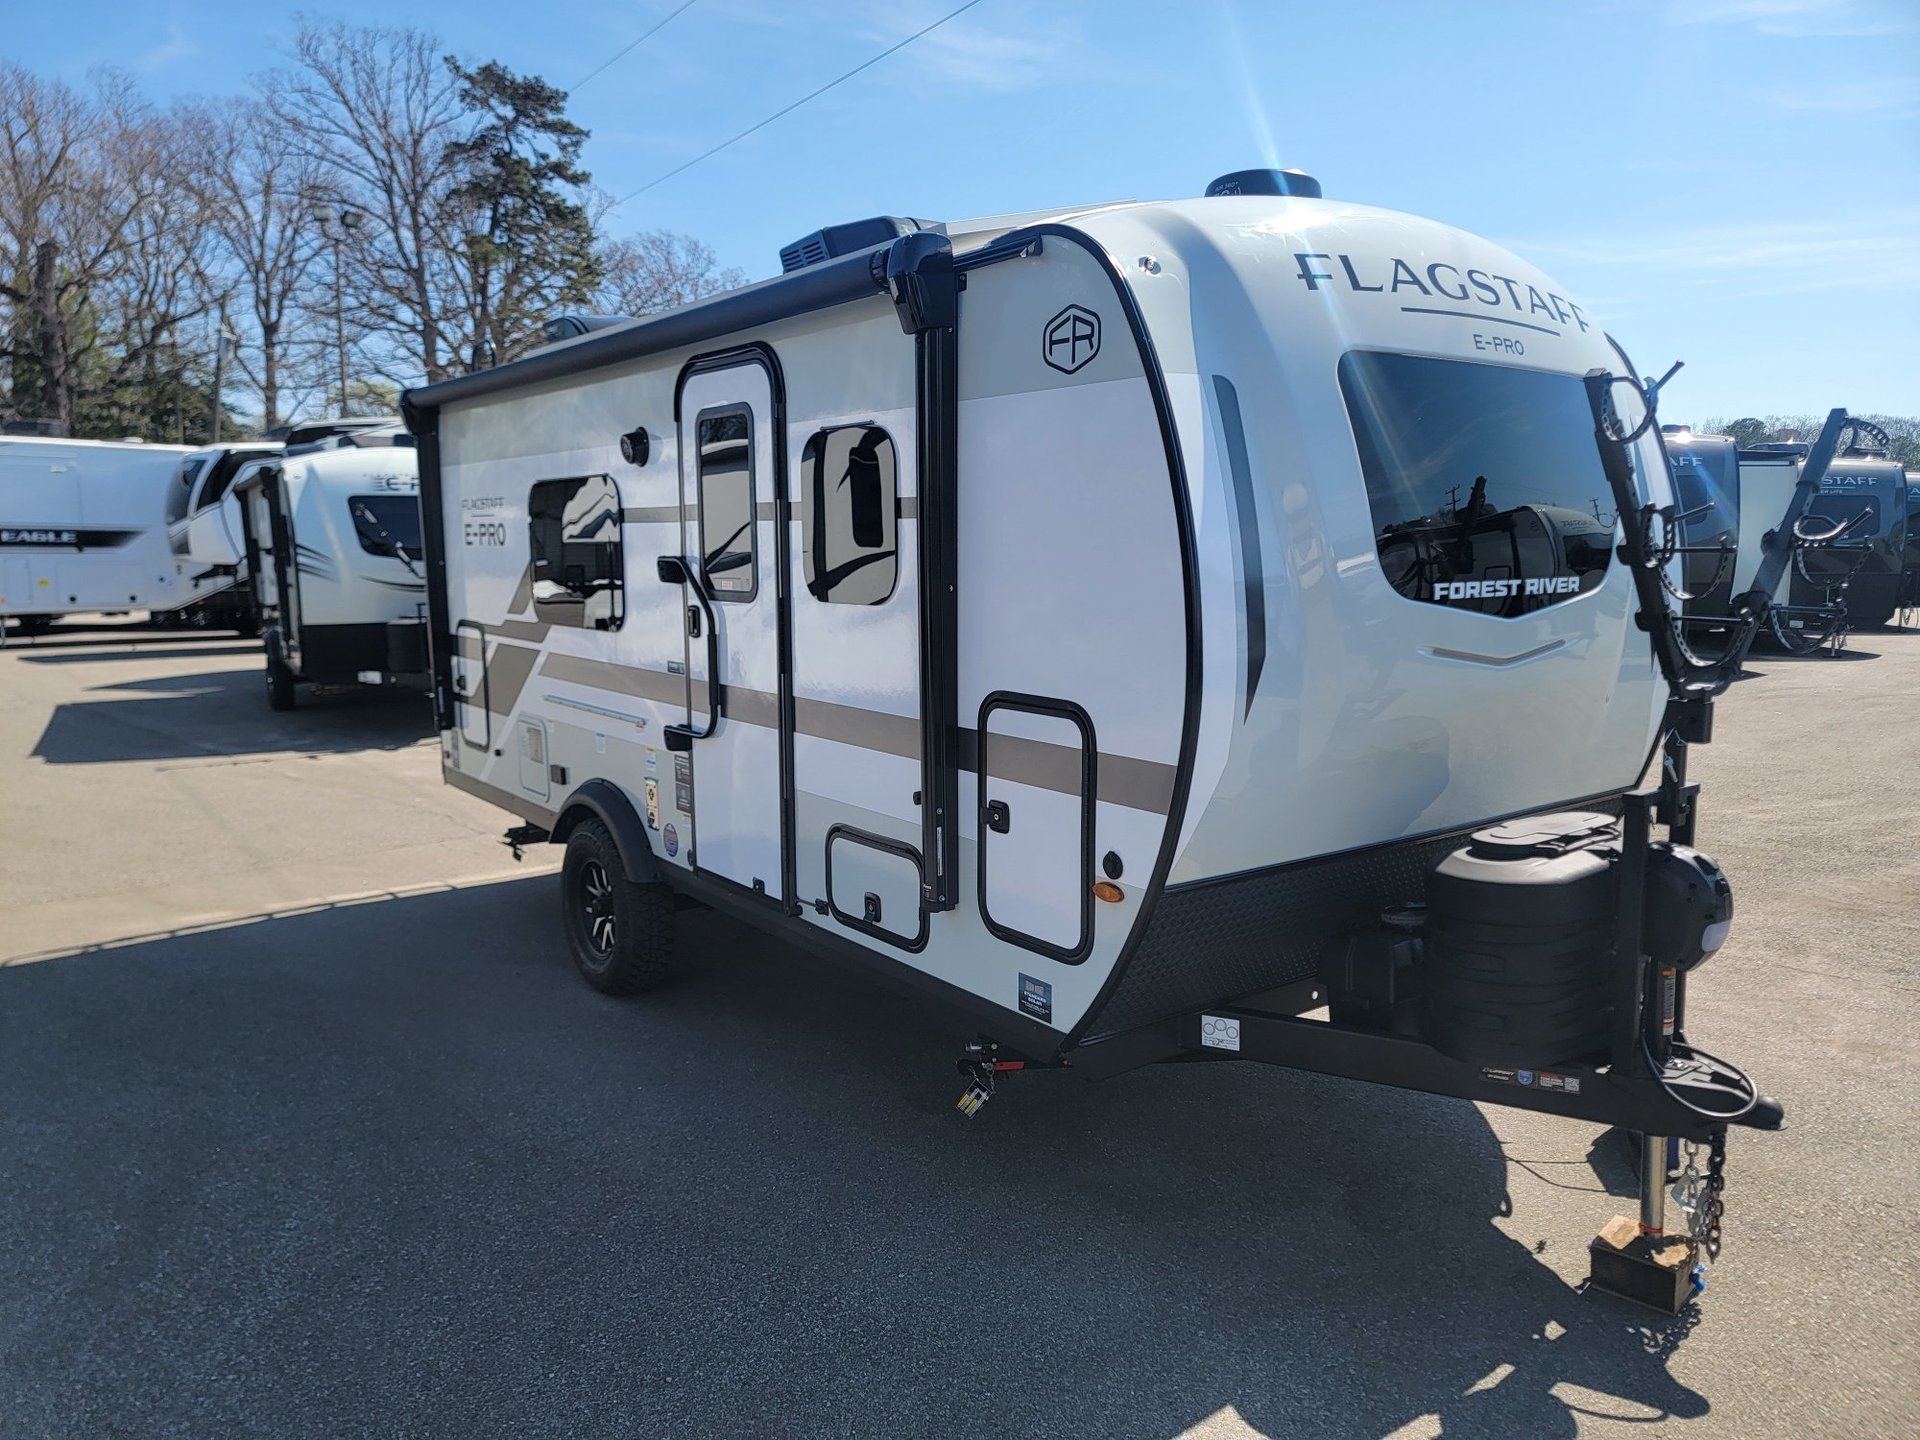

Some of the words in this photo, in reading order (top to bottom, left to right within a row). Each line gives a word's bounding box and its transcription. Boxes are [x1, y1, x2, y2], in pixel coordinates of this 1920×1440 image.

[1294, 253, 1590, 333] FLAGSTAFF
[1472, 333, 1525, 356] E-PRO
[1822, 476, 1878, 486] STAFF
[0, 530, 77, 543] EAGLE
[464, 522, 507, 547] E-PRO
[1433, 579, 1523, 601] FOREST
[1524, 576, 1580, 596] RIVER
